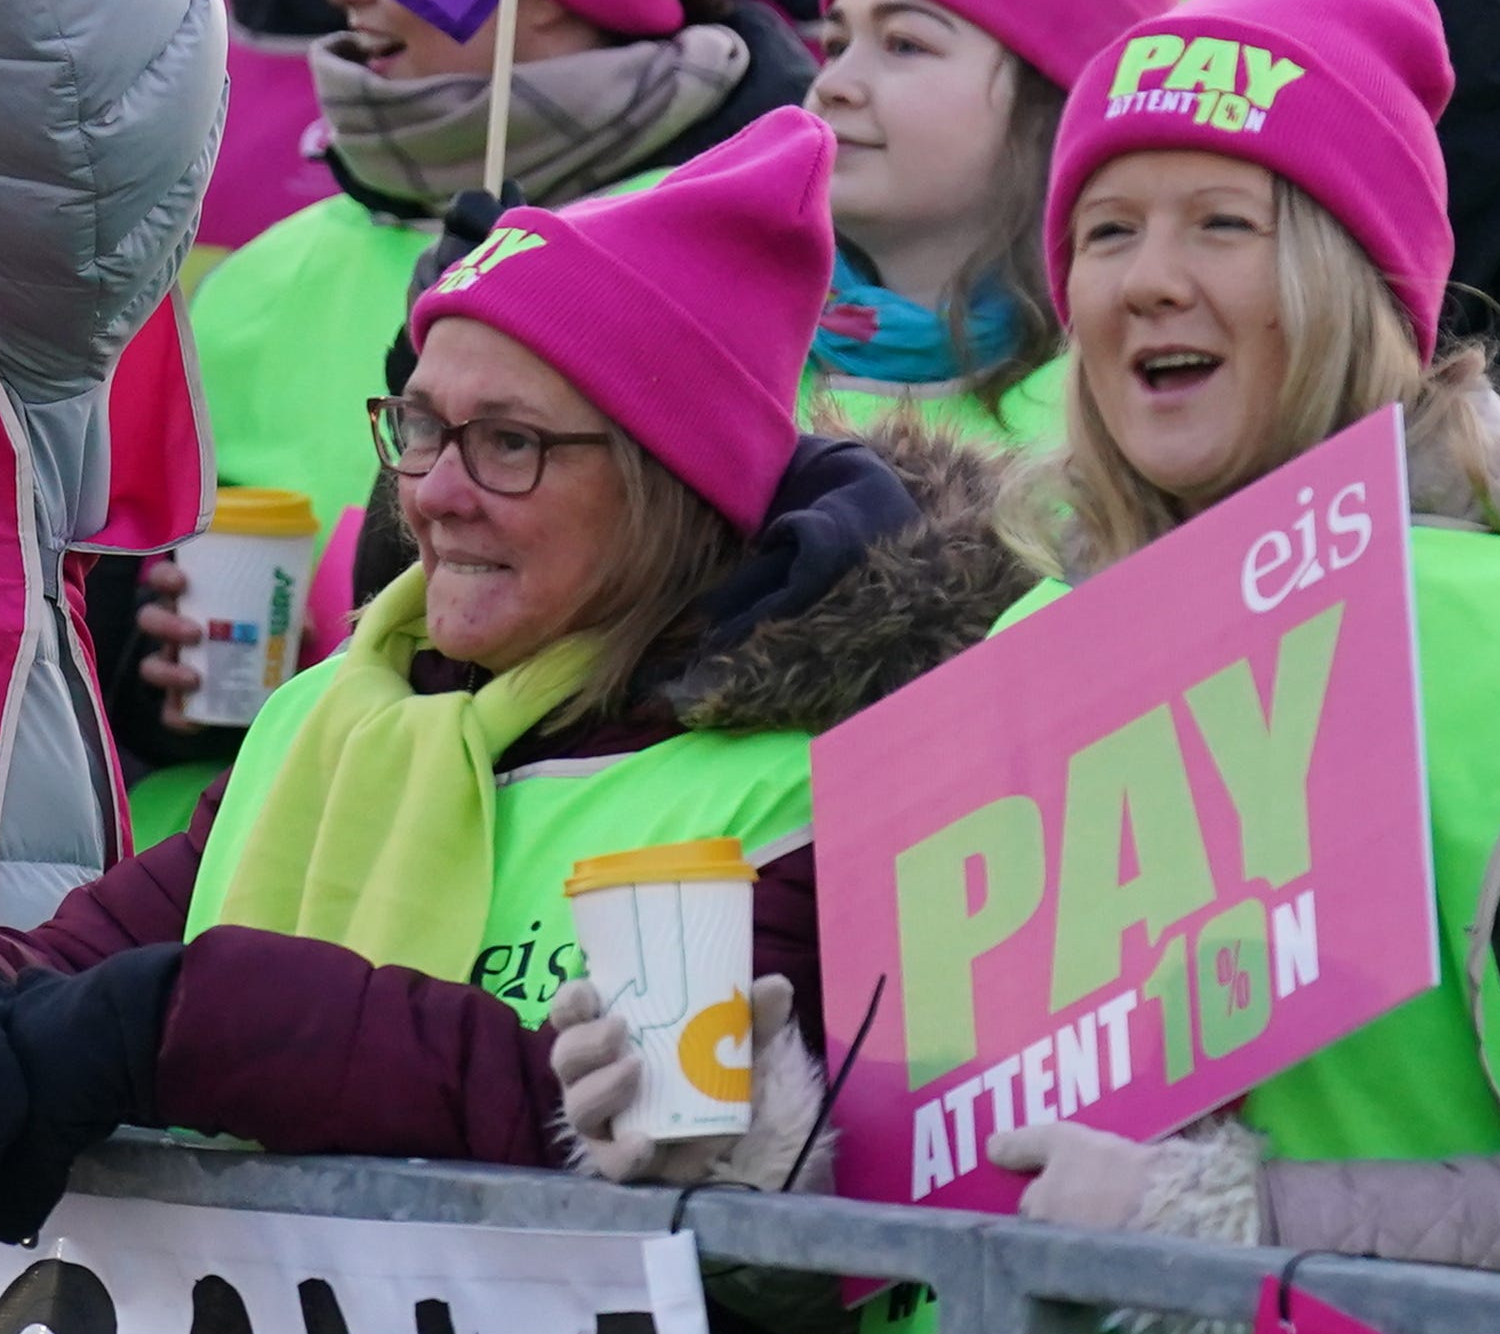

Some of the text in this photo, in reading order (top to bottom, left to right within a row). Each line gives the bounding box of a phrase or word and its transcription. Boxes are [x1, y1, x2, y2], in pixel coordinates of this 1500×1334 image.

[1108, 34, 1306, 110] PAY
[1241, 478, 1376, 614] eis
[895, 599, 1346, 1094] PAY
